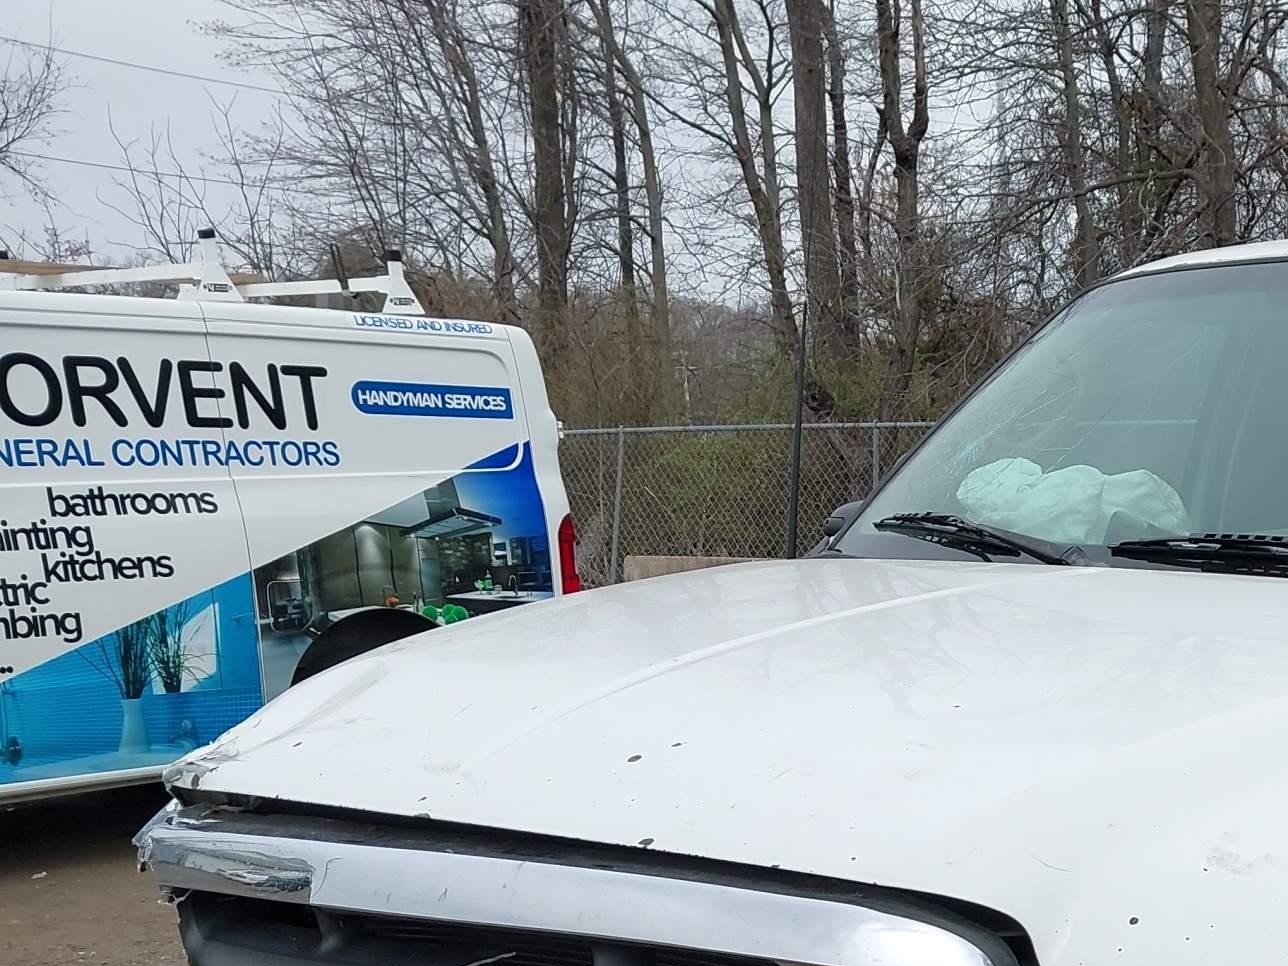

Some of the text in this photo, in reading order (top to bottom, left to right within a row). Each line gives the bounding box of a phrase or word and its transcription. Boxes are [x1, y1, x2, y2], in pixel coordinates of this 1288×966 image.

[353, 315, 493, 334] LICENSED AND INSURED
[357, 389, 507, 411] HANDYMAN SERVICES
[111, 438, 341, 467] CONTRACTORS
[46, 486, 219, 517] bathrooms
[41, 550, 175, 583] kitchens
